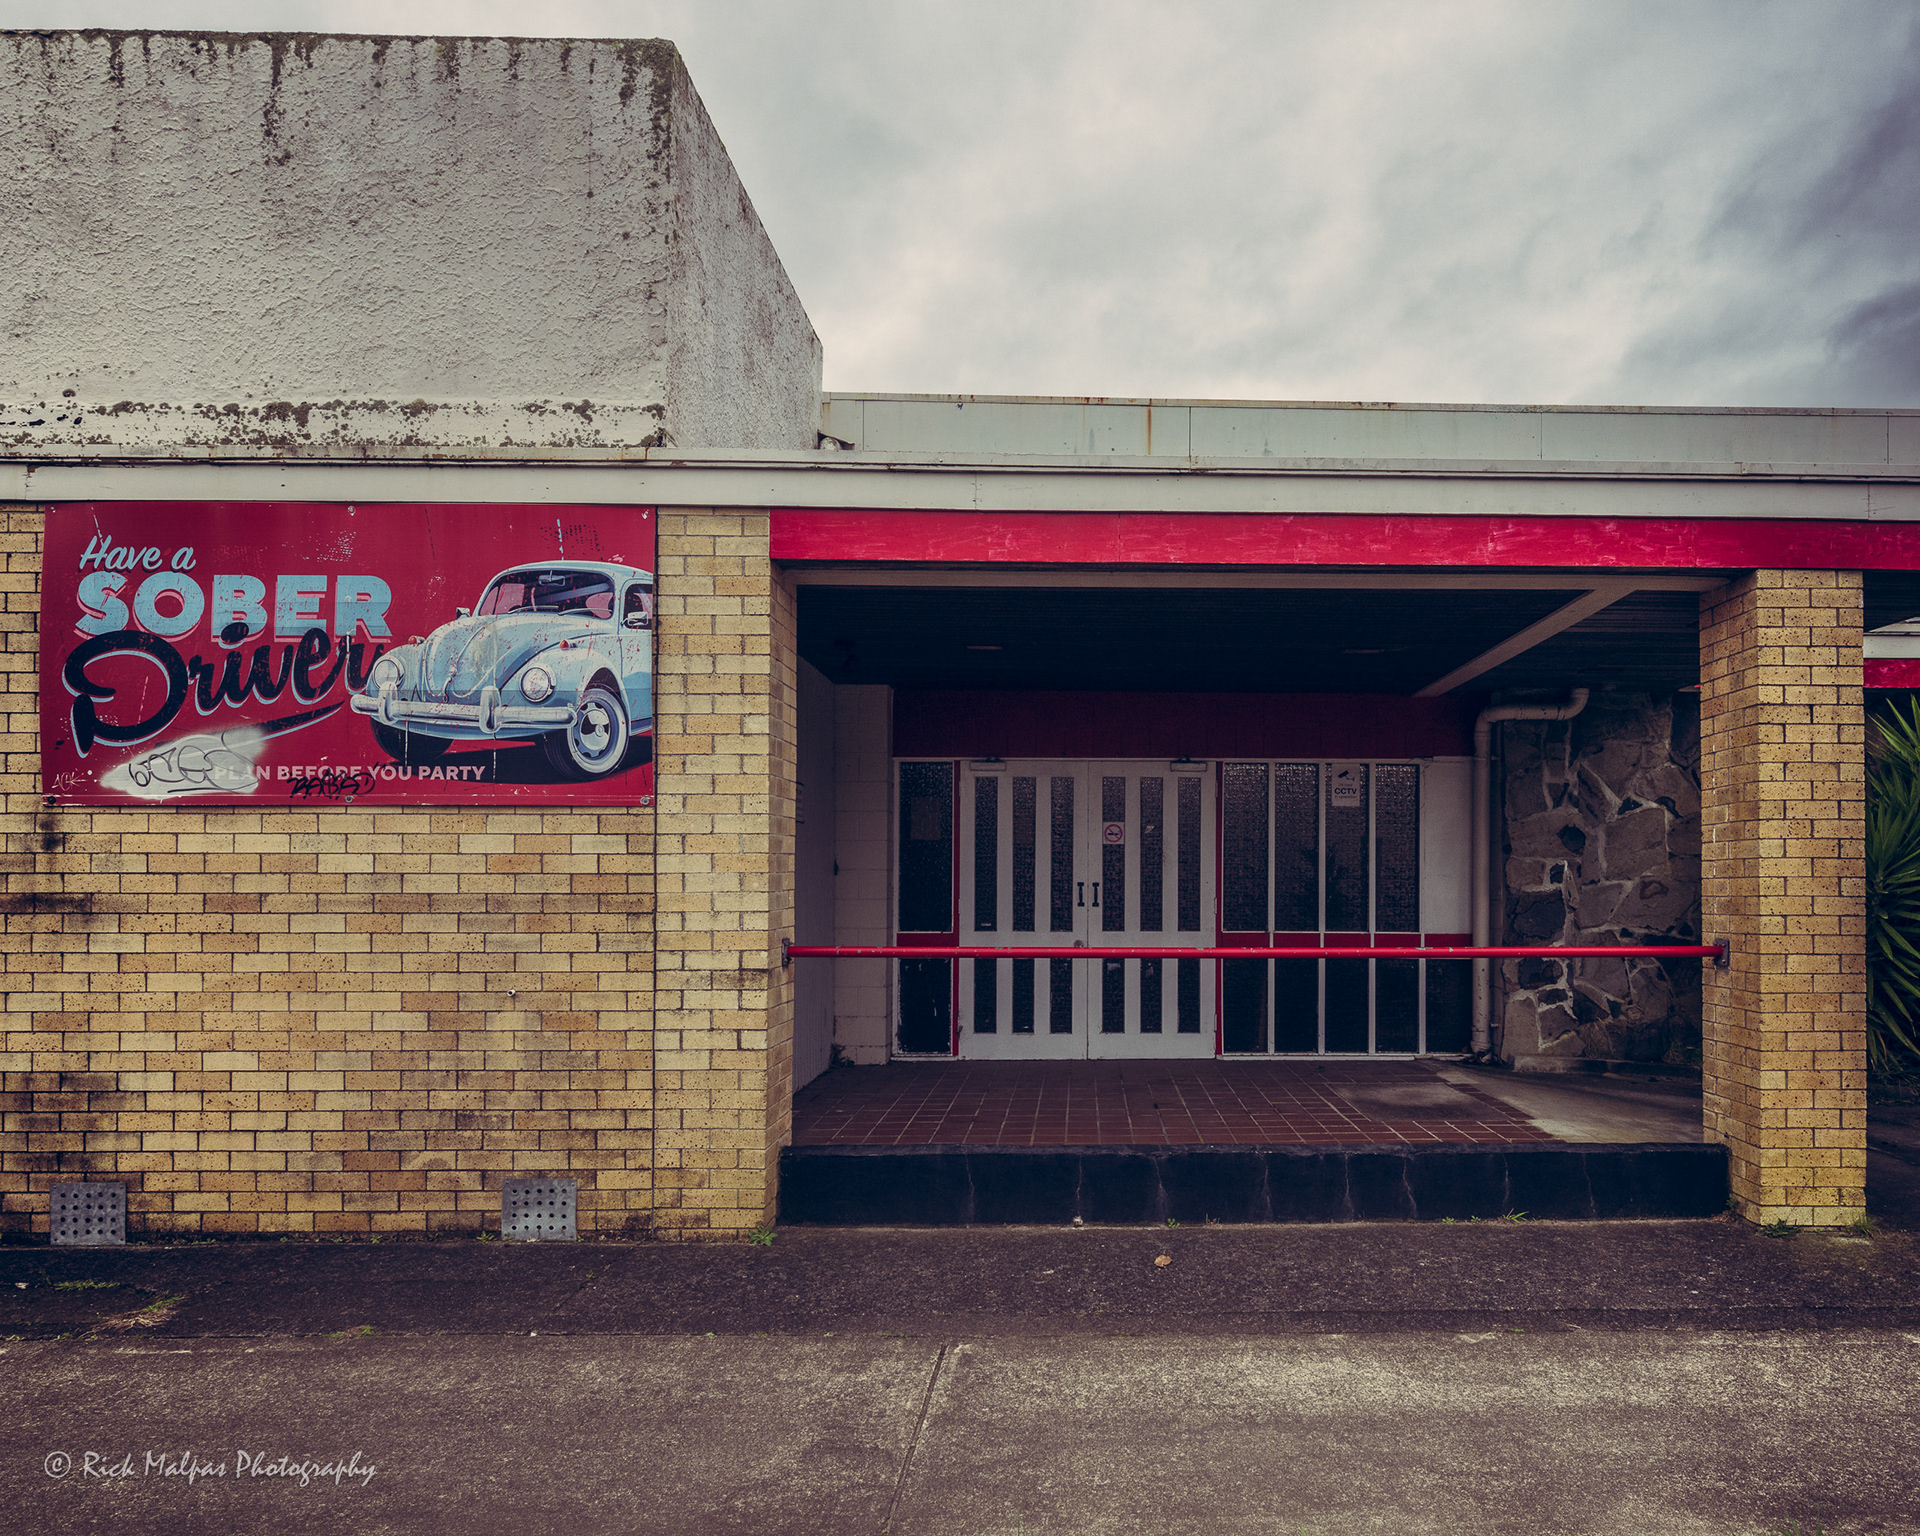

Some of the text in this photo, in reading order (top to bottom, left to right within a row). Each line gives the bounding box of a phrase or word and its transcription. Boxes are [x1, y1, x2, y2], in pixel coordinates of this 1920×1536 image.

[79, 534, 196, 572] Have a
[74, 572, 393, 643] SOBER
[214, 765, 486, 781] PLAN BEFORE YOU PARTY
[1334, 787, 1357, 795] CCTV
